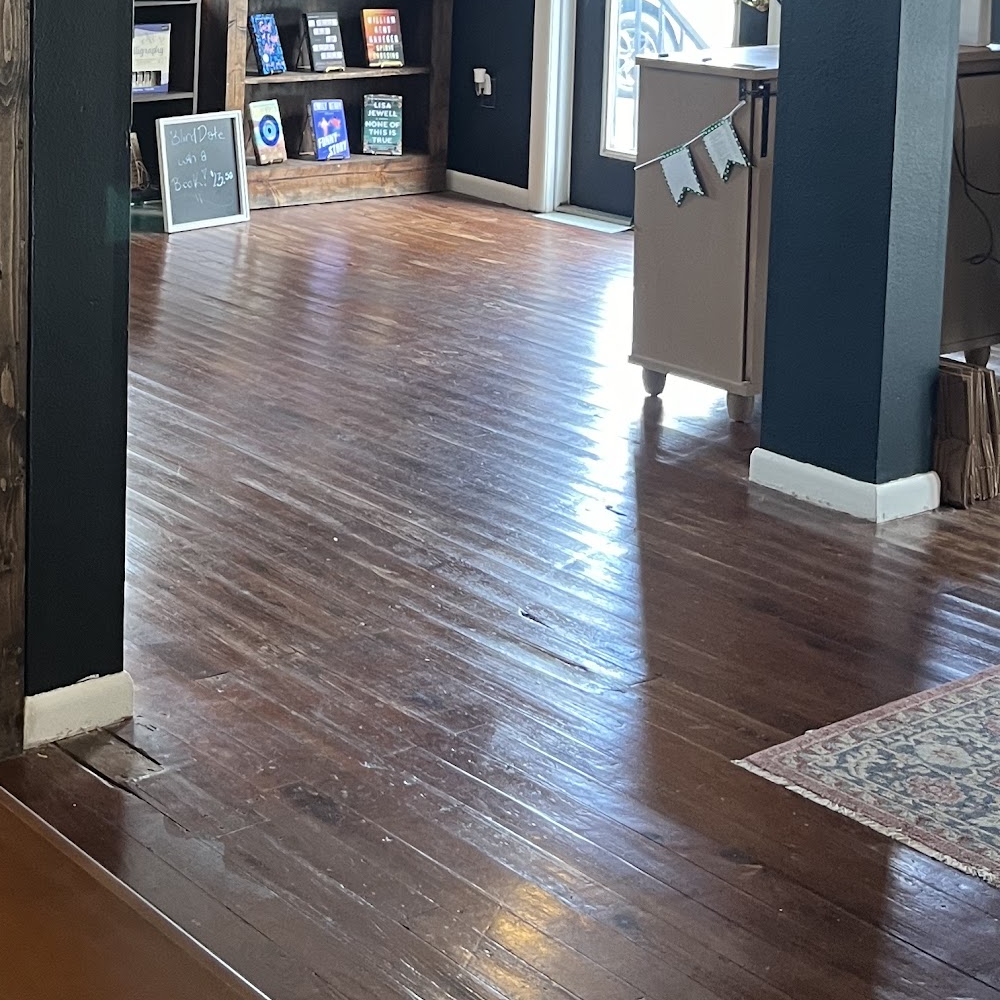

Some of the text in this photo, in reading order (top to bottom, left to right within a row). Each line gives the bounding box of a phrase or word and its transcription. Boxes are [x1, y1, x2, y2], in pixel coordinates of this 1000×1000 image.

[367, 15, 396, 24] WILLIAM
[373, 101, 392, 109] LISA
[367, 109, 398, 117] JEWELL
[197, 124, 226, 143] Date
